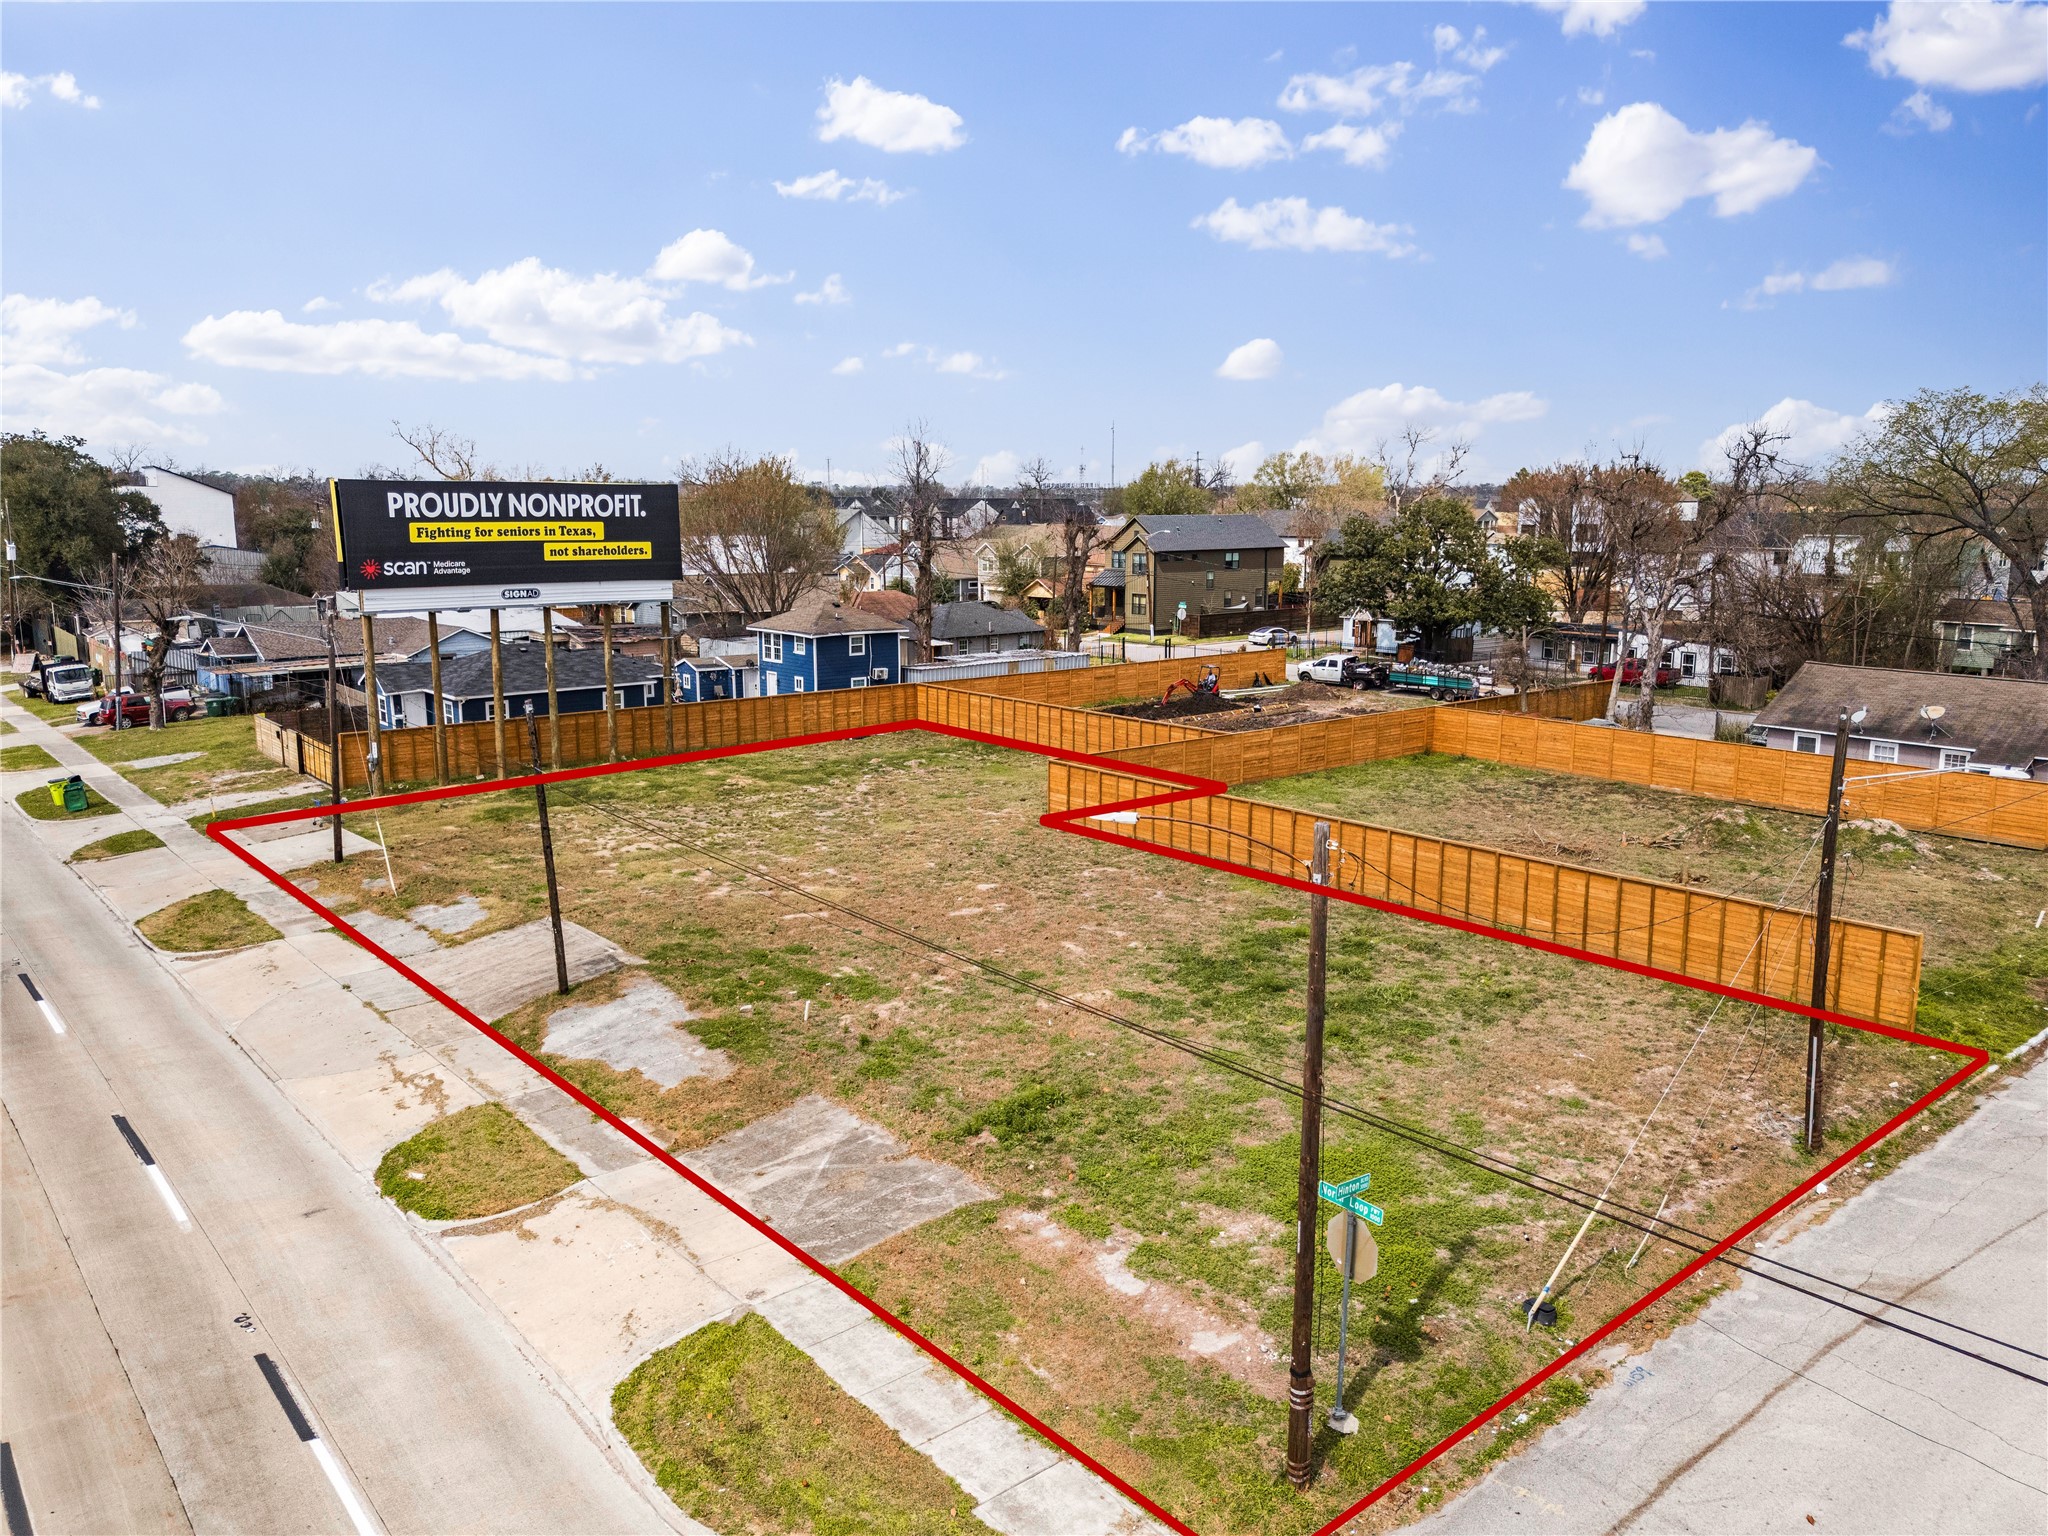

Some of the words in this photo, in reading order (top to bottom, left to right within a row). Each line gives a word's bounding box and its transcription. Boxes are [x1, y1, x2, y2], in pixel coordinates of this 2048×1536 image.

[387, 492, 503, 518] PROUDLY
[508, 493, 647, 518] NONPROFIT.
[416, 527, 471, 540] Fighting
[475, 527, 494, 537] for
[497, 526, 541, 537] seniors
[544, 526, 556, 536] in
[558, 525, 596, 538] Texas,
[549, 547, 569, 557] not
[572, 545, 648, 557] shareholders.
[433, 560, 466, 568] Medicare
[433, 567, 471, 576] Advantage
[1338, 1182, 1360, 1197] Hinton
[1349, 1197, 1368, 1215] Loop
[1370, 1207, 1380, 1216] FWY
